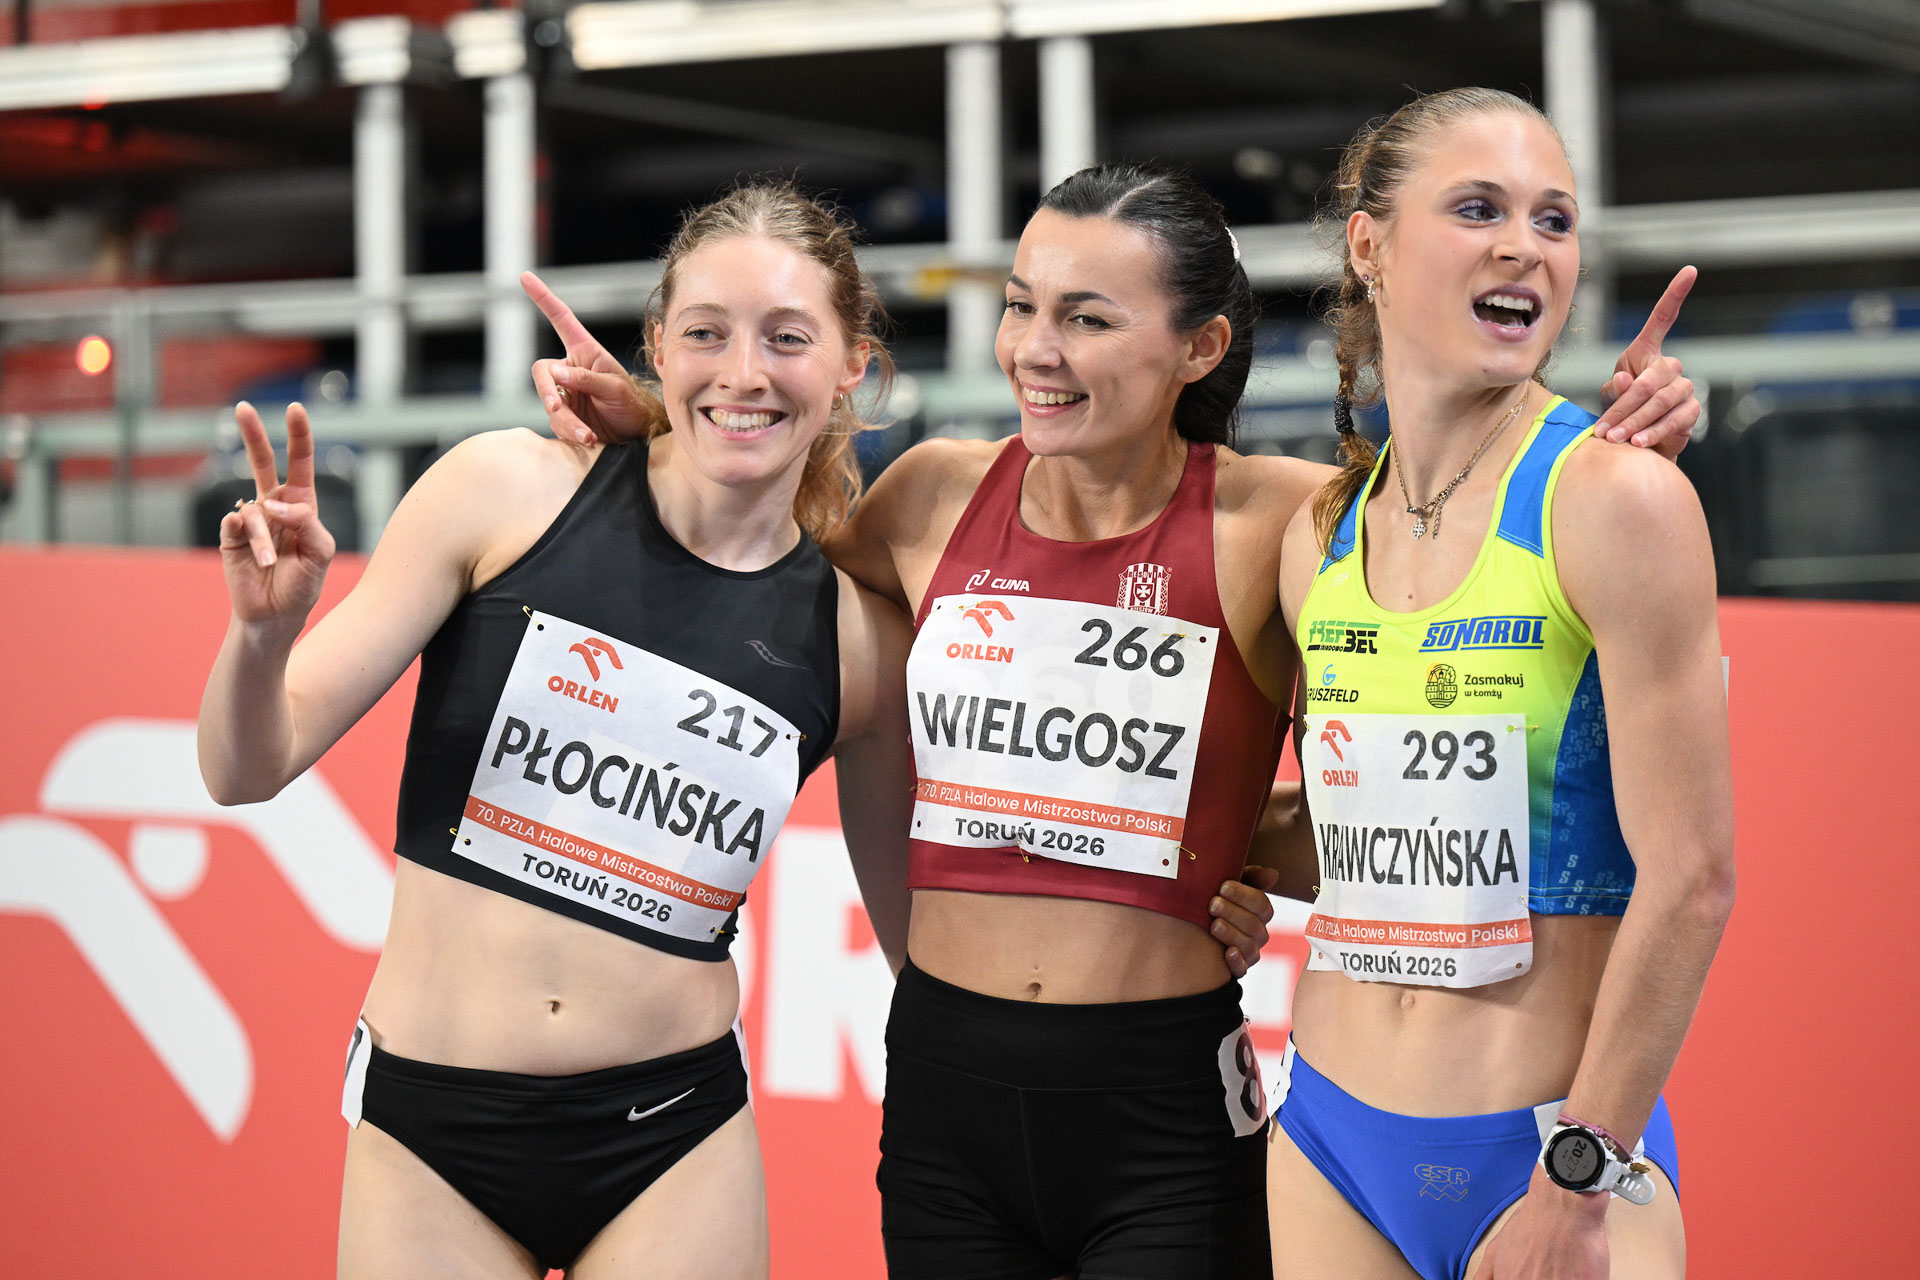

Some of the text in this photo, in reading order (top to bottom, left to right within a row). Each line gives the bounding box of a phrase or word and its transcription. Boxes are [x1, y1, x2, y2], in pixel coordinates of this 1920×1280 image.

[990, 577, 1030, 592] CUNA
[1129, 571, 1162, 579] RESOVIA
[946, 642, 1014, 663] ORLEN
[1074, 618, 1185, 678] 266
[1419, 616, 1547, 652] SONAROL
[548, 675, 619, 713] ORLEN
[1464, 673, 1524, 688] Zasmakuj
[1473, 689, 1502, 699] Łomży
[676, 688, 779, 758] 217
[916, 691, 1186, 780] WIELGOSZ
[1403, 730, 1498, 781] 293
[490, 715, 765, 863] PŁOCIŃSKA
[1322, 769, 1358, 787] ORLEN
[924, 783, 1172, 834] 70. PZLA Halowe Mistrzostwa Polski
[476, 804, 734, 908] 70. PZLA Halowe Mistrzostwa Polski
[955, 817, 1105, 856] TORUŃ 2026
[1319, 816, 1520, 888] KRAWCZYŃSKA
[522, 852, 673, 922] TORUŃ 2026
[1315, 919, 1325, 933] 70.
[1343, 923, 1386, 939] Halowe
[1388, 926, 1467, 943] Mistrzostwa
[1471, 923, 1519, 943] Polski
[1340, 949, 1457, 977] TORUŃ 2026
[1235, 1031, 1262, 1122] 8
